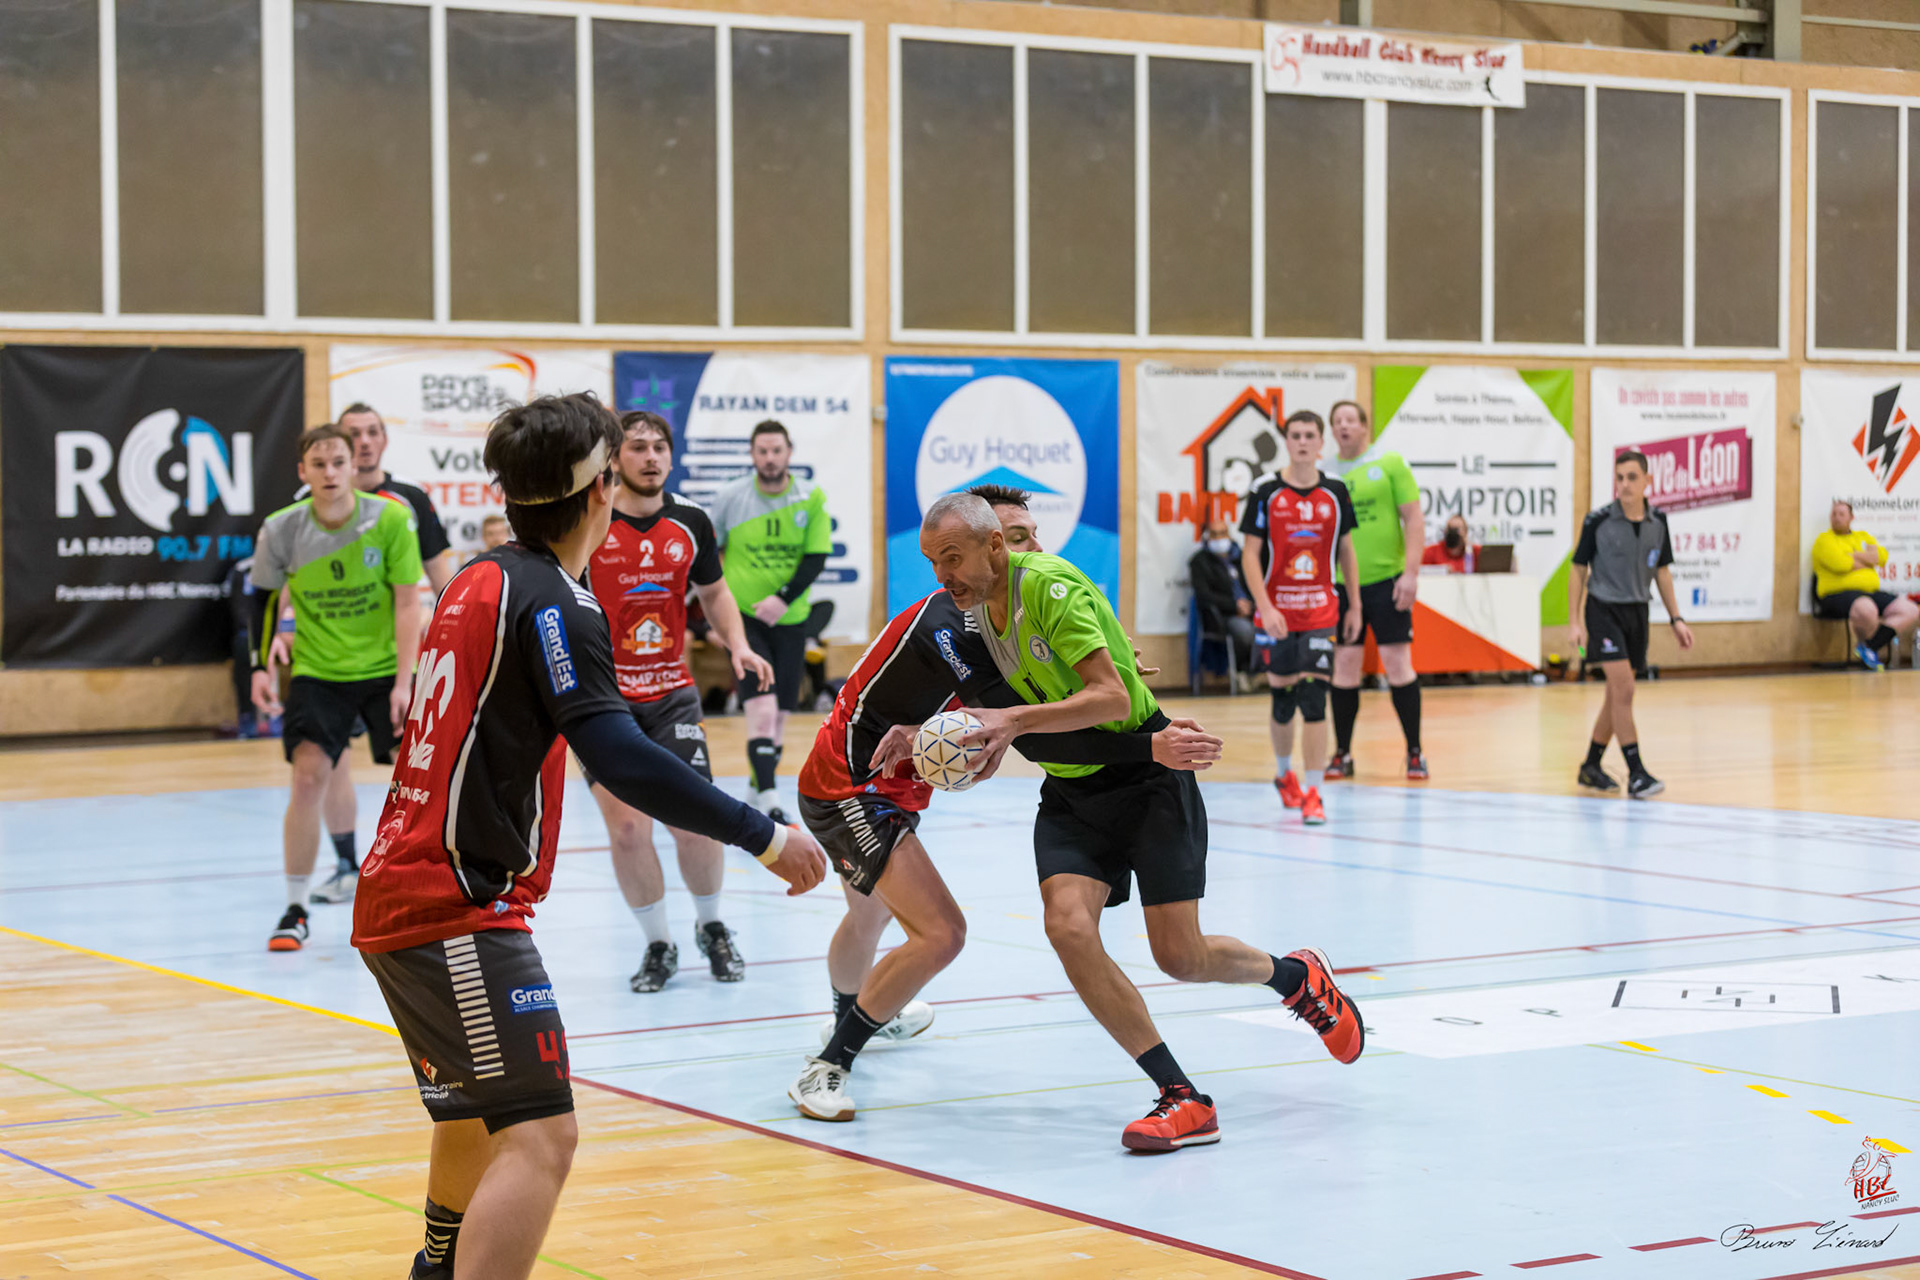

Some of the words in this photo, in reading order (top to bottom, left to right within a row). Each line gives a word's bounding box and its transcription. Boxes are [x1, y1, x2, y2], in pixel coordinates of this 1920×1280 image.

[1302, 34, 1370, 58] Handball
[1379, 41, 1414, 64] Club
[699, 395, 768, 412] RAYAN
[774, 397, 817, 412] DEM
[825, 398, 849, 413] 54
[928, 435, 977, 469] Guy
[985, 437, 1072, 468] Hoquet
[1462, 456, 1484, 475] LE
[1688, 434, 1740, 488] Léon
[1420, 487, 1557, 517] OMPTOIR
[57, 537, 84, 557] LA
[87, 536, 154, 556] RADIO
[157, 535, 211, 562] 90.7
[639, 539, 655, 568] 2
[329, 559, 345, 581] 9
[618, 573, 638, 585] Guy
[640, 571, 674, 584] Hoquet
